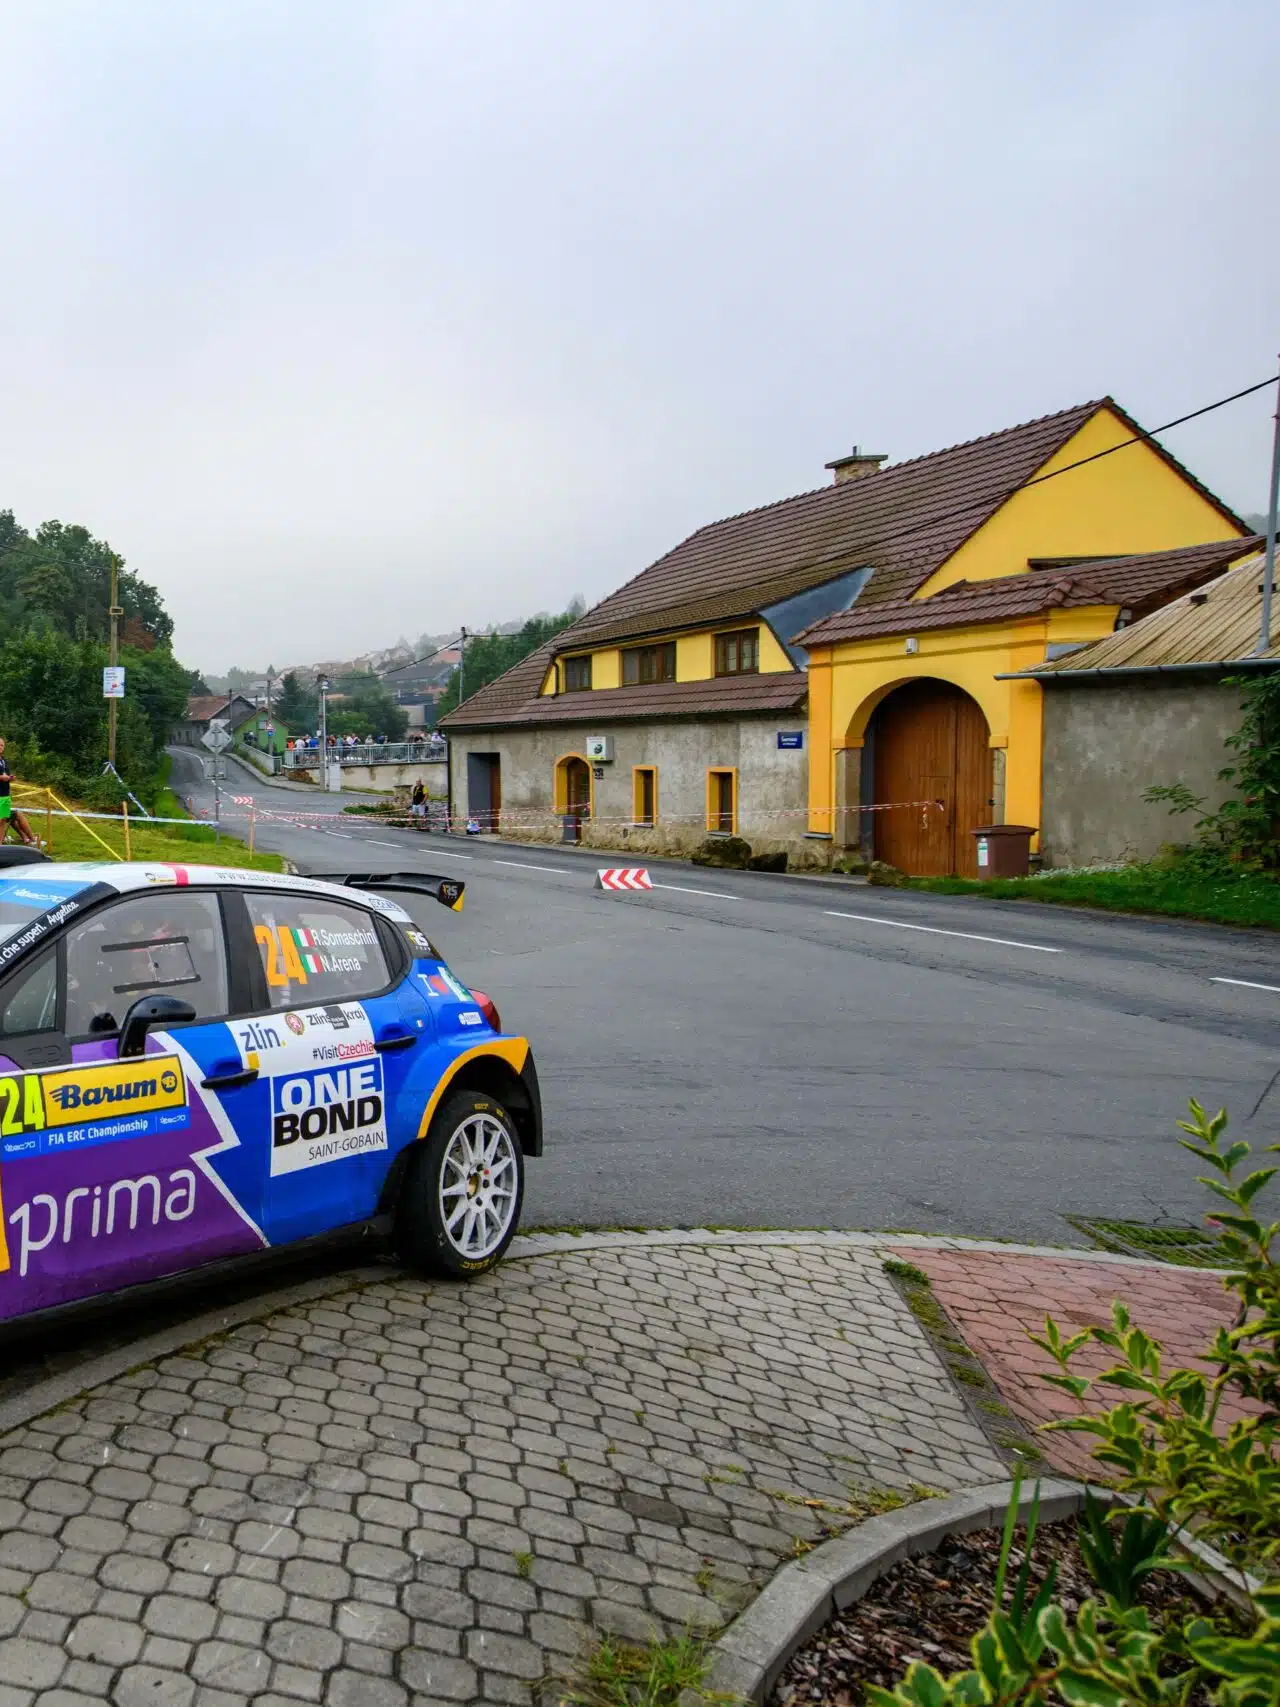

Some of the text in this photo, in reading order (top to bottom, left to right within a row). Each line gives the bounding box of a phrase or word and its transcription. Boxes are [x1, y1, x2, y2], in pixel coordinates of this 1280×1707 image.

[2, 942, 20, 959] che
[254, 925, 308, 986] 24
[343, 1008, 366, 1020] kraj
[312, 1040, 375, 1060] #VisitCzechia
[50, 1078, 157, 1110] Barum
[281, 1064, 376, 1112] ONE
[48, 1132, 65, 1146] FIA
[67, 1129, 86, 1143] ERC
[88, 1118, 149, 1139] Championship
[274, 1095, 383, 1148] BOND
[309, 1131, 385, 1160] SAINT-GOBAIN
[9, 1169, 196, 1277] prima
